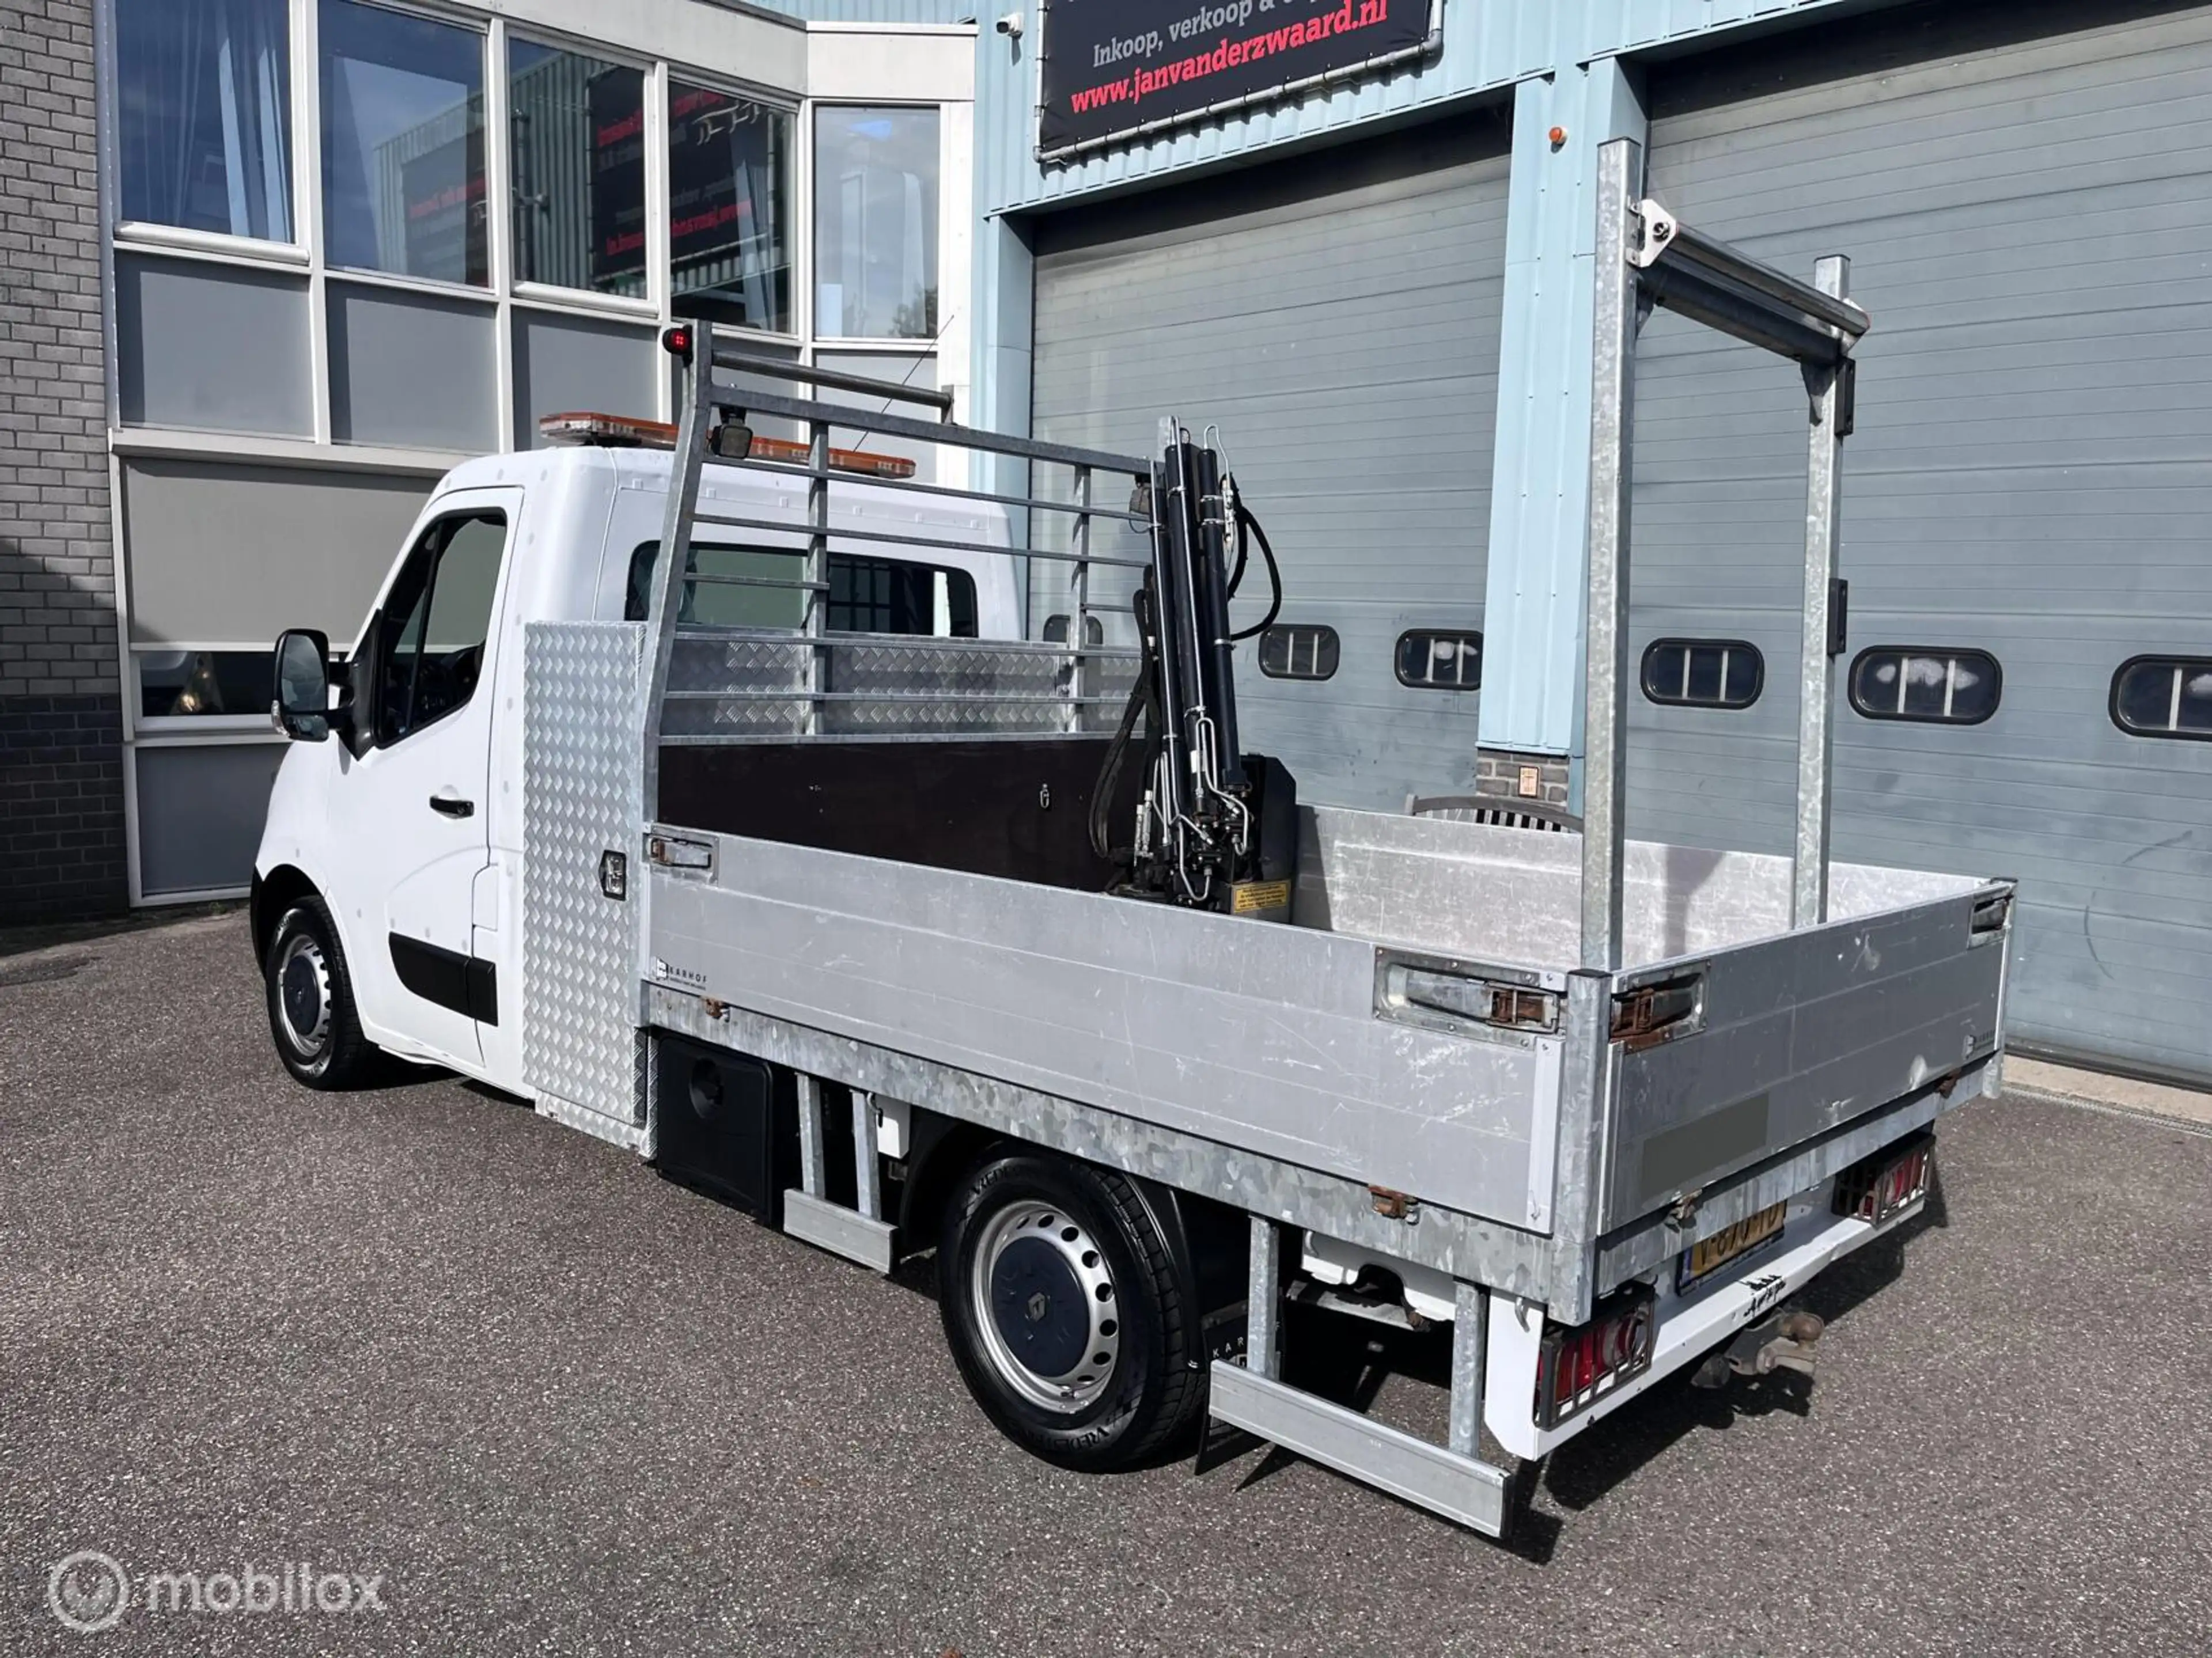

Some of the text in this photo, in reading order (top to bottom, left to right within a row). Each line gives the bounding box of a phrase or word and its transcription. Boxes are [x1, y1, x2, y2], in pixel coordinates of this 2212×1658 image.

[1071, 0, 1387, 113] www.janvanderzwaard.nl
[1093, 30, 1163, 67] Inkoop,
[1169, 0, 1252, 42] verkoop
